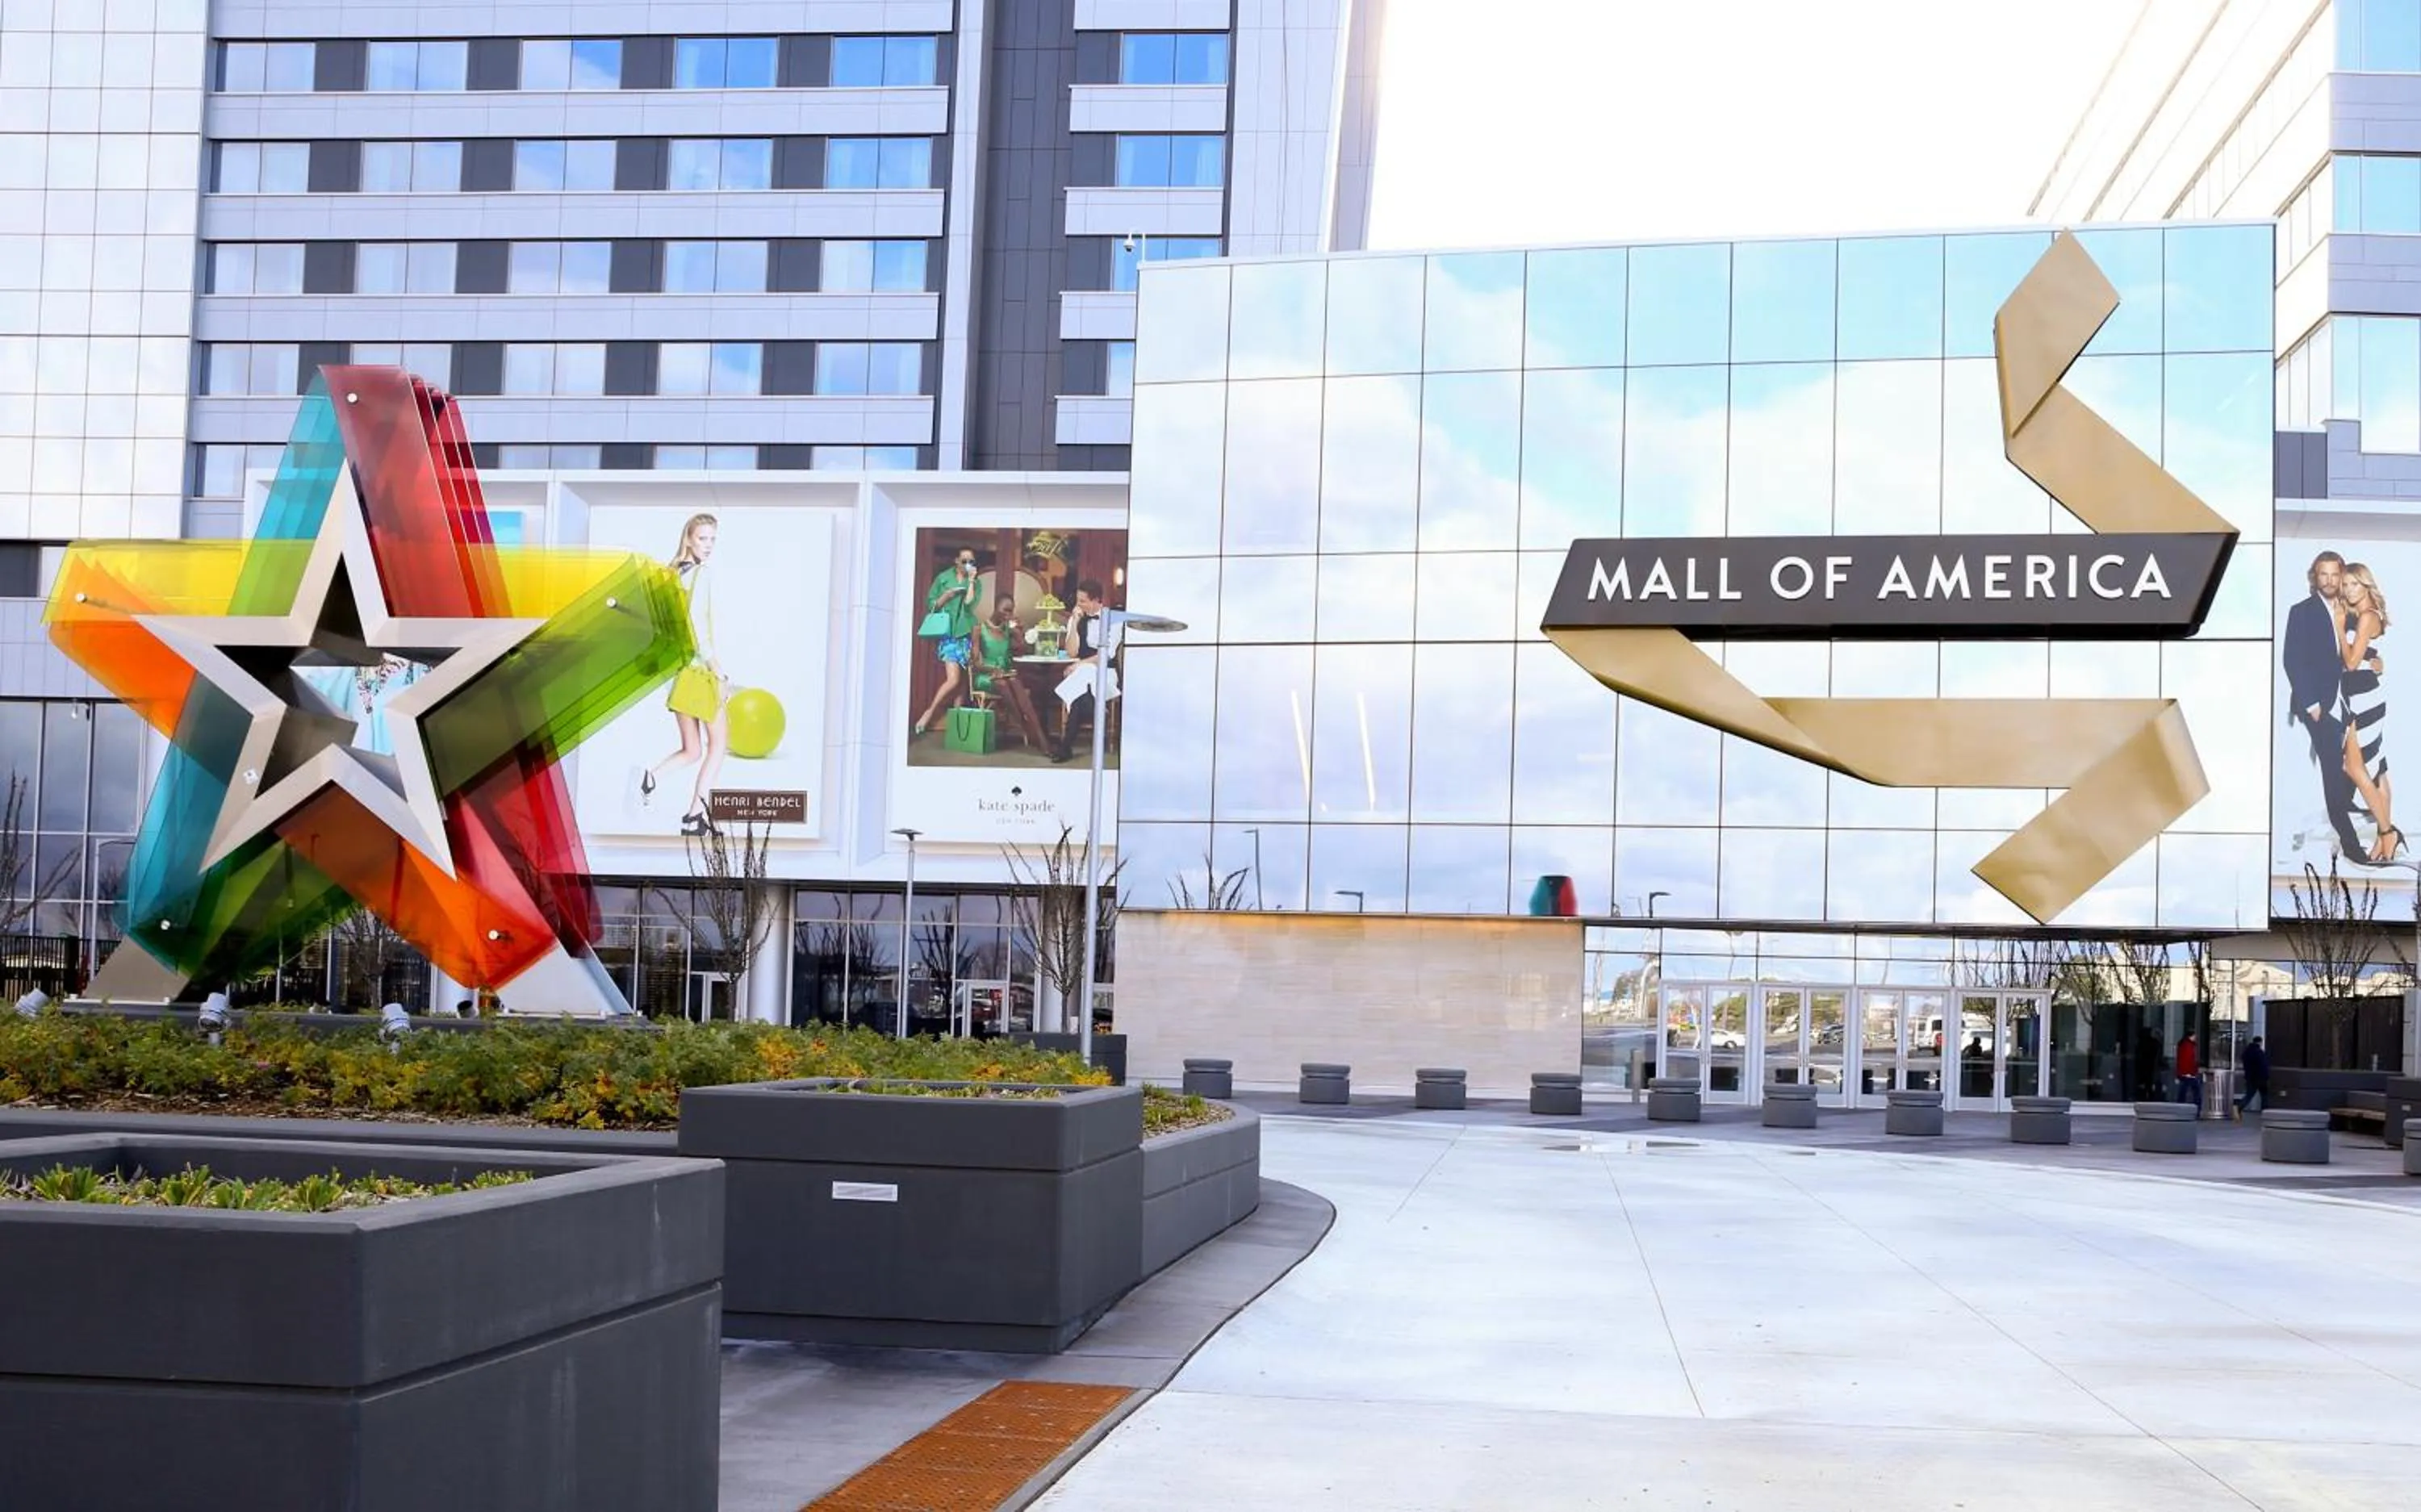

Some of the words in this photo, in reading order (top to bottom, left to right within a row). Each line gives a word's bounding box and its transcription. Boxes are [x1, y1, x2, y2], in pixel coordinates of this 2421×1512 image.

[1587, 557, 1742, 601] MALL
[1770, 556, 1852, 599] OF
[1877, 553, 2172, 599] AMERICA
[714, 796, 751, 806] HENRI
[757, 796, 801, 808] BENDEL
[979, 799, 1009, 811] kate
[1014, 800, 1056, 816] spade
